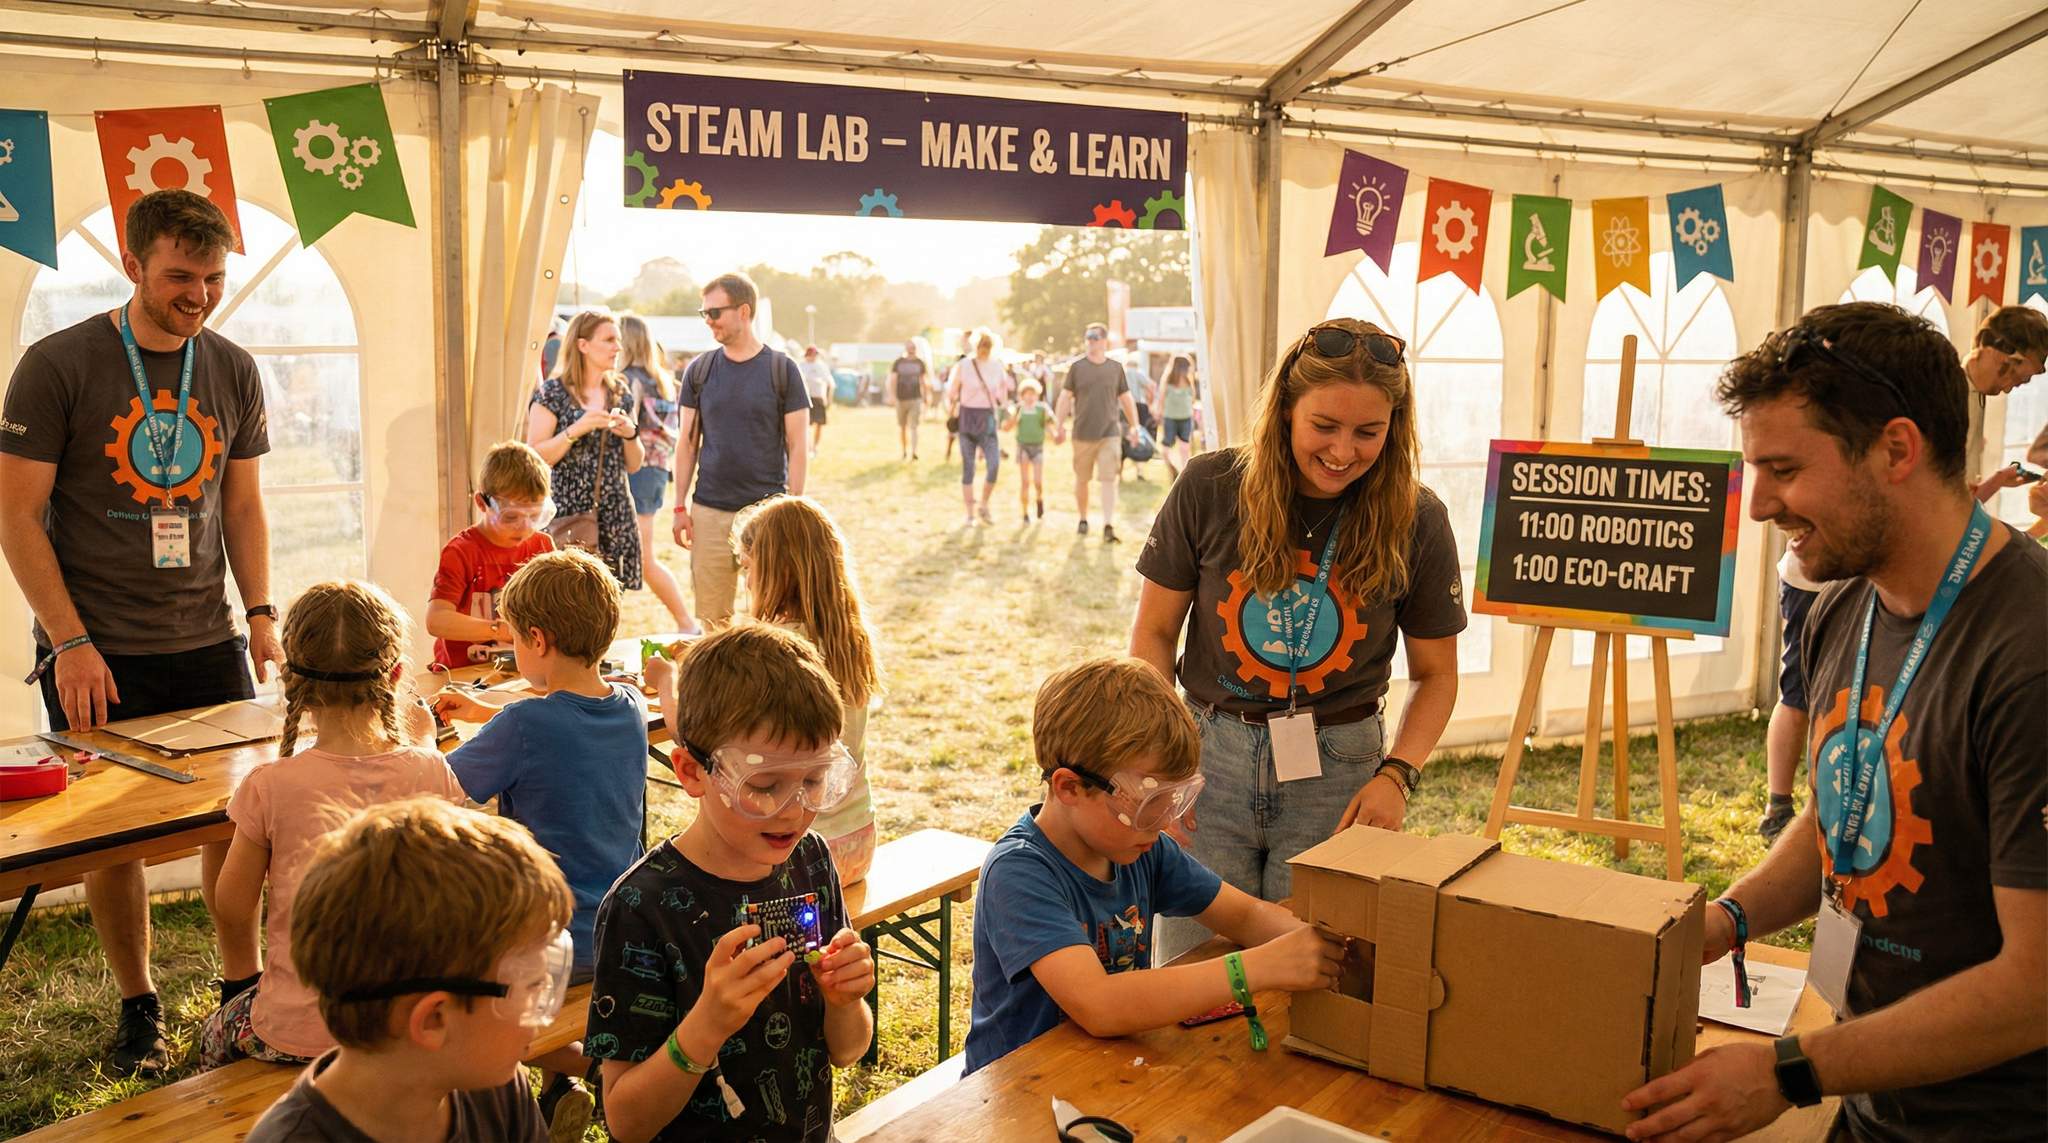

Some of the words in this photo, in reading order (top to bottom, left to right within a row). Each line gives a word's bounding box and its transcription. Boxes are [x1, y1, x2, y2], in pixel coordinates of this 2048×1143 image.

[646, 101, 783, 158] STEAM
[797, 111, 869, 163] LAB
[921, 120, 1019, 172] MAKE
[1029, 128, 1058, 174] &
[1069, 131, 1172, 181] LEARN
[1511, 461, 1617, 497] SESSION
[1625, 467, 1712, 503] TIMES:
[1518, 510, 1575, 541] 11:00
[1580, 514, 1695, 550] ROBOTICS
[1512, 553, 1559, 583] 1:00
[1564, 557, 1696, 594] ECO-CRAFT
